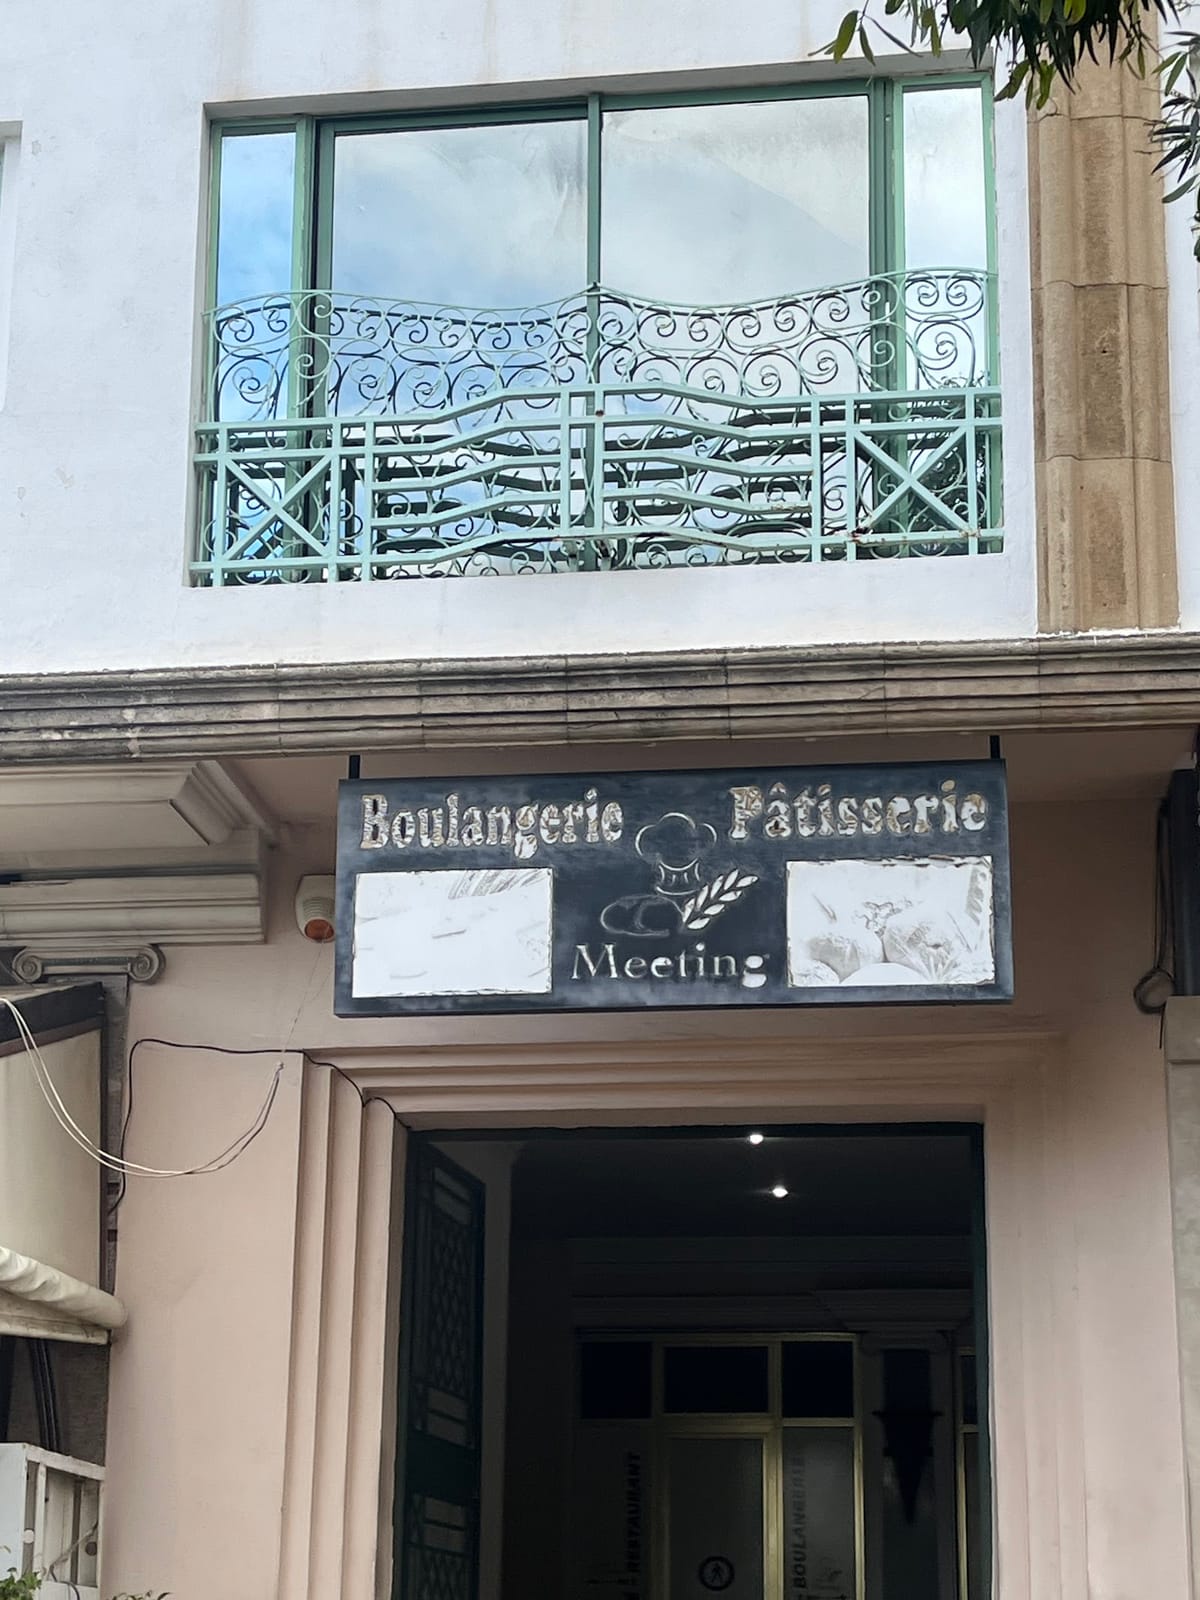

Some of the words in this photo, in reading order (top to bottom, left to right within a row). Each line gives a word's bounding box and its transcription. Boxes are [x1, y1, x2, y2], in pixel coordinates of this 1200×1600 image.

[360, 788, 624, 859] Boulangerie
[729, 780, 986, 839] Pâtisserie
[571, 942, 770, 988] Meeting
